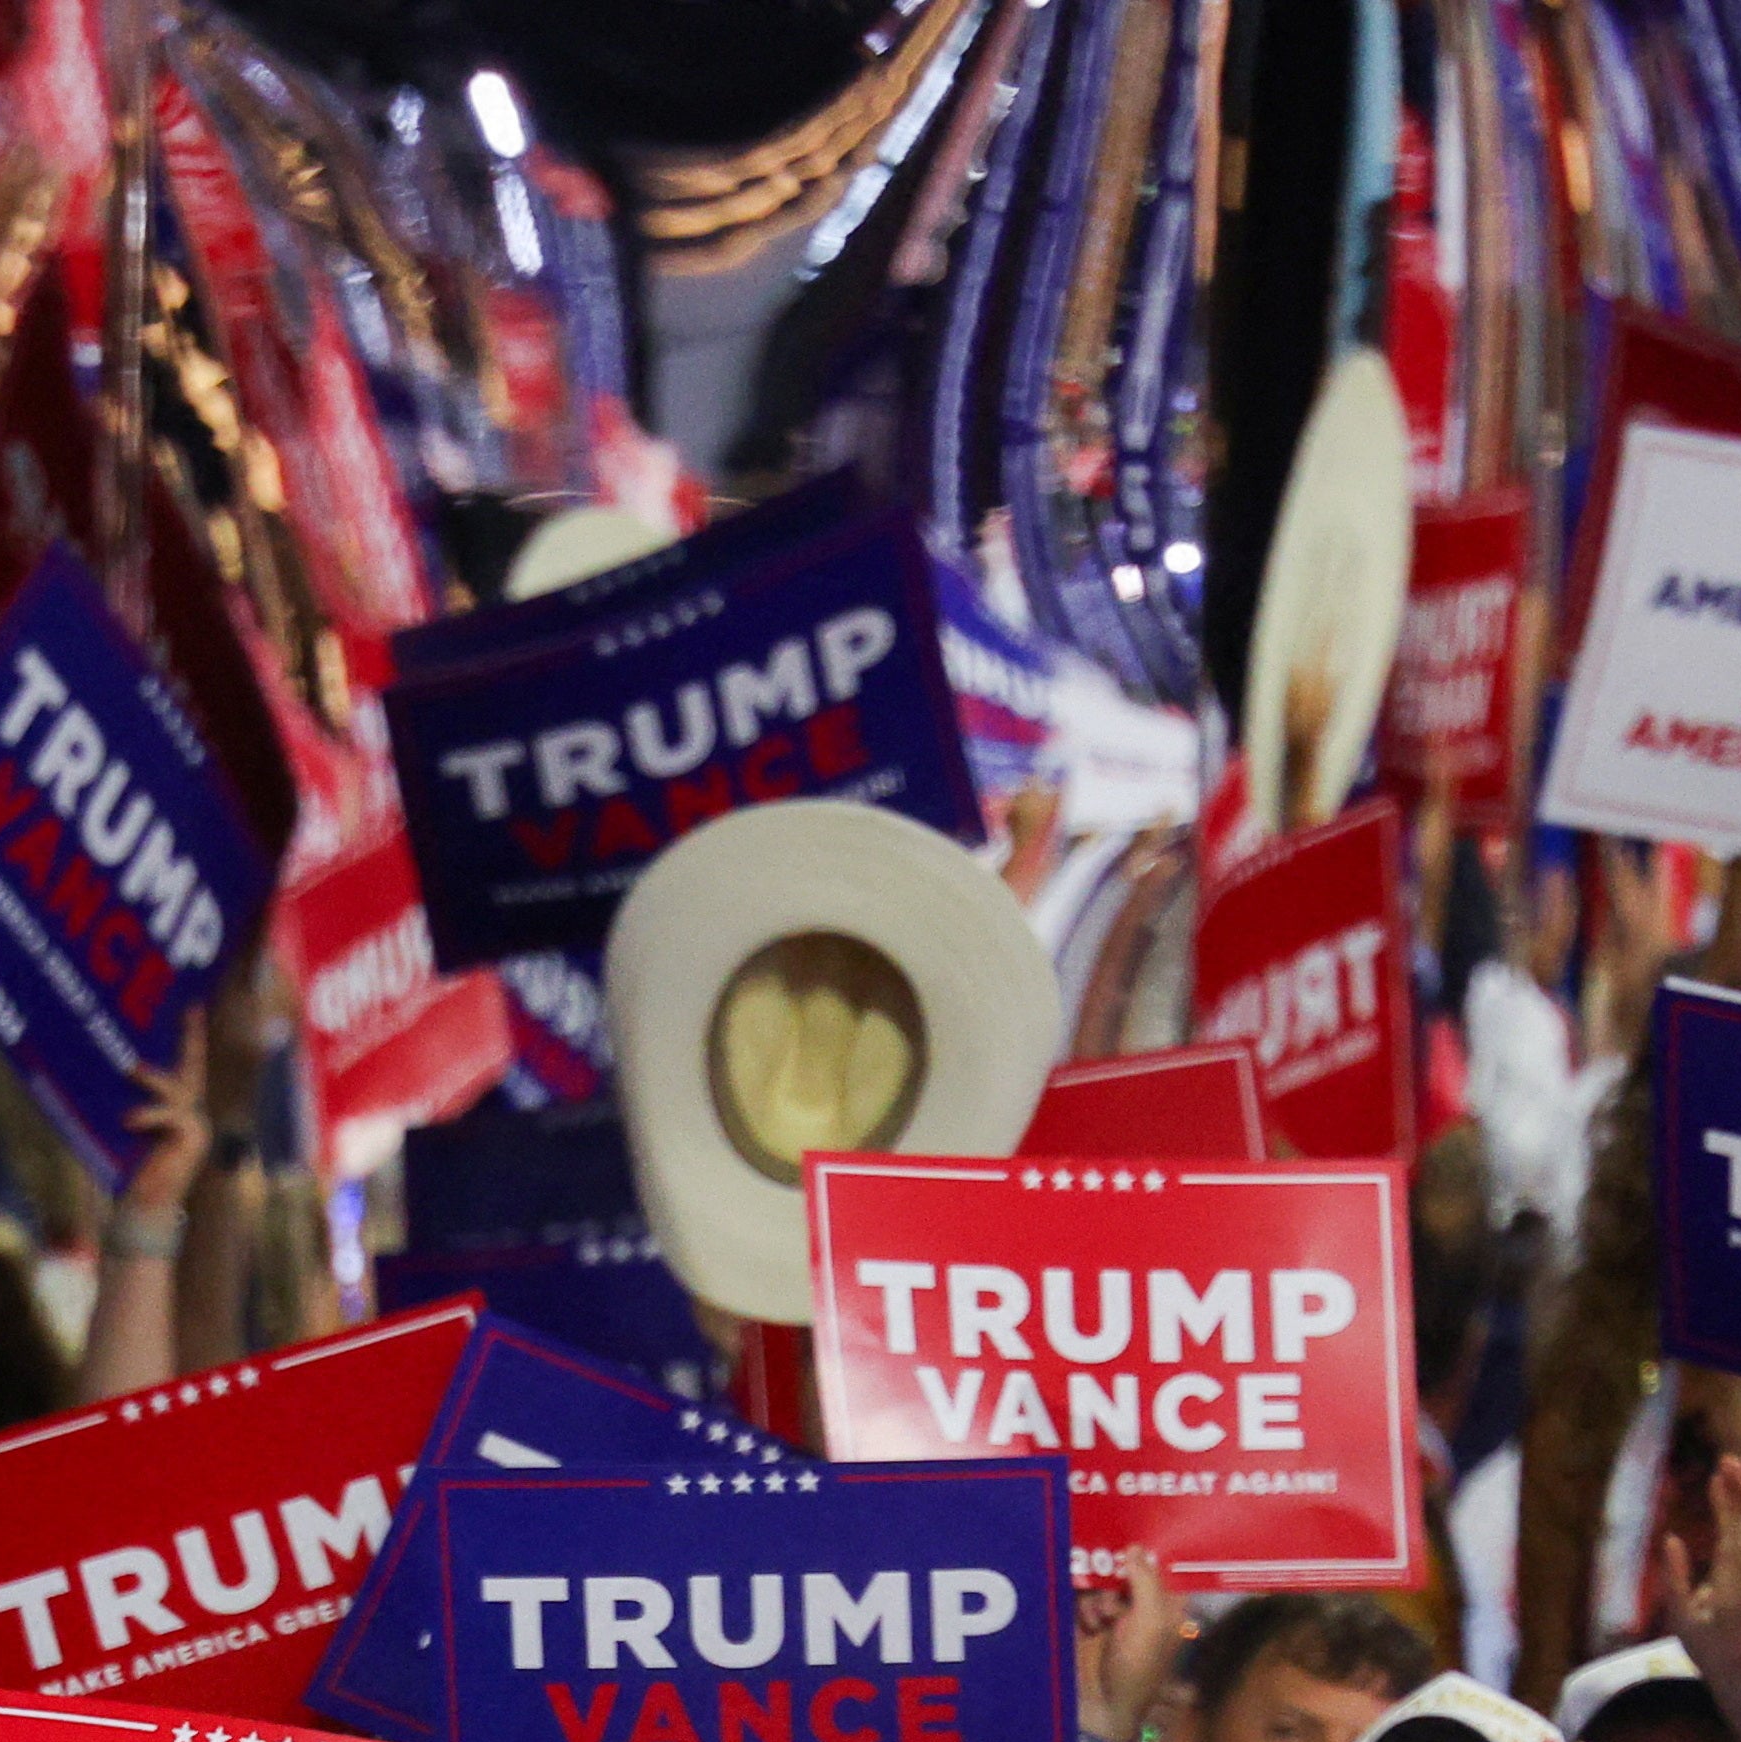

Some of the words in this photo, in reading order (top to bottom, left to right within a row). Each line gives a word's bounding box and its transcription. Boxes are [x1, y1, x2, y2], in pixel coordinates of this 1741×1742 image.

[438, 604, 899, 823] TRUMP
[508, 703, 872, 871] VANCE
[857, 1259, 1358, 1364] TRUMP
[916, 1365, 1305, 1452] VANCE
[1117, 1471, 1217, 1498] GREAT
[1226, 1470, 1338, 1497] AGAIN!
[132, 1621, 268, 1683] AMERICA
[480, 1567, 1019, 1671] TRUMP
